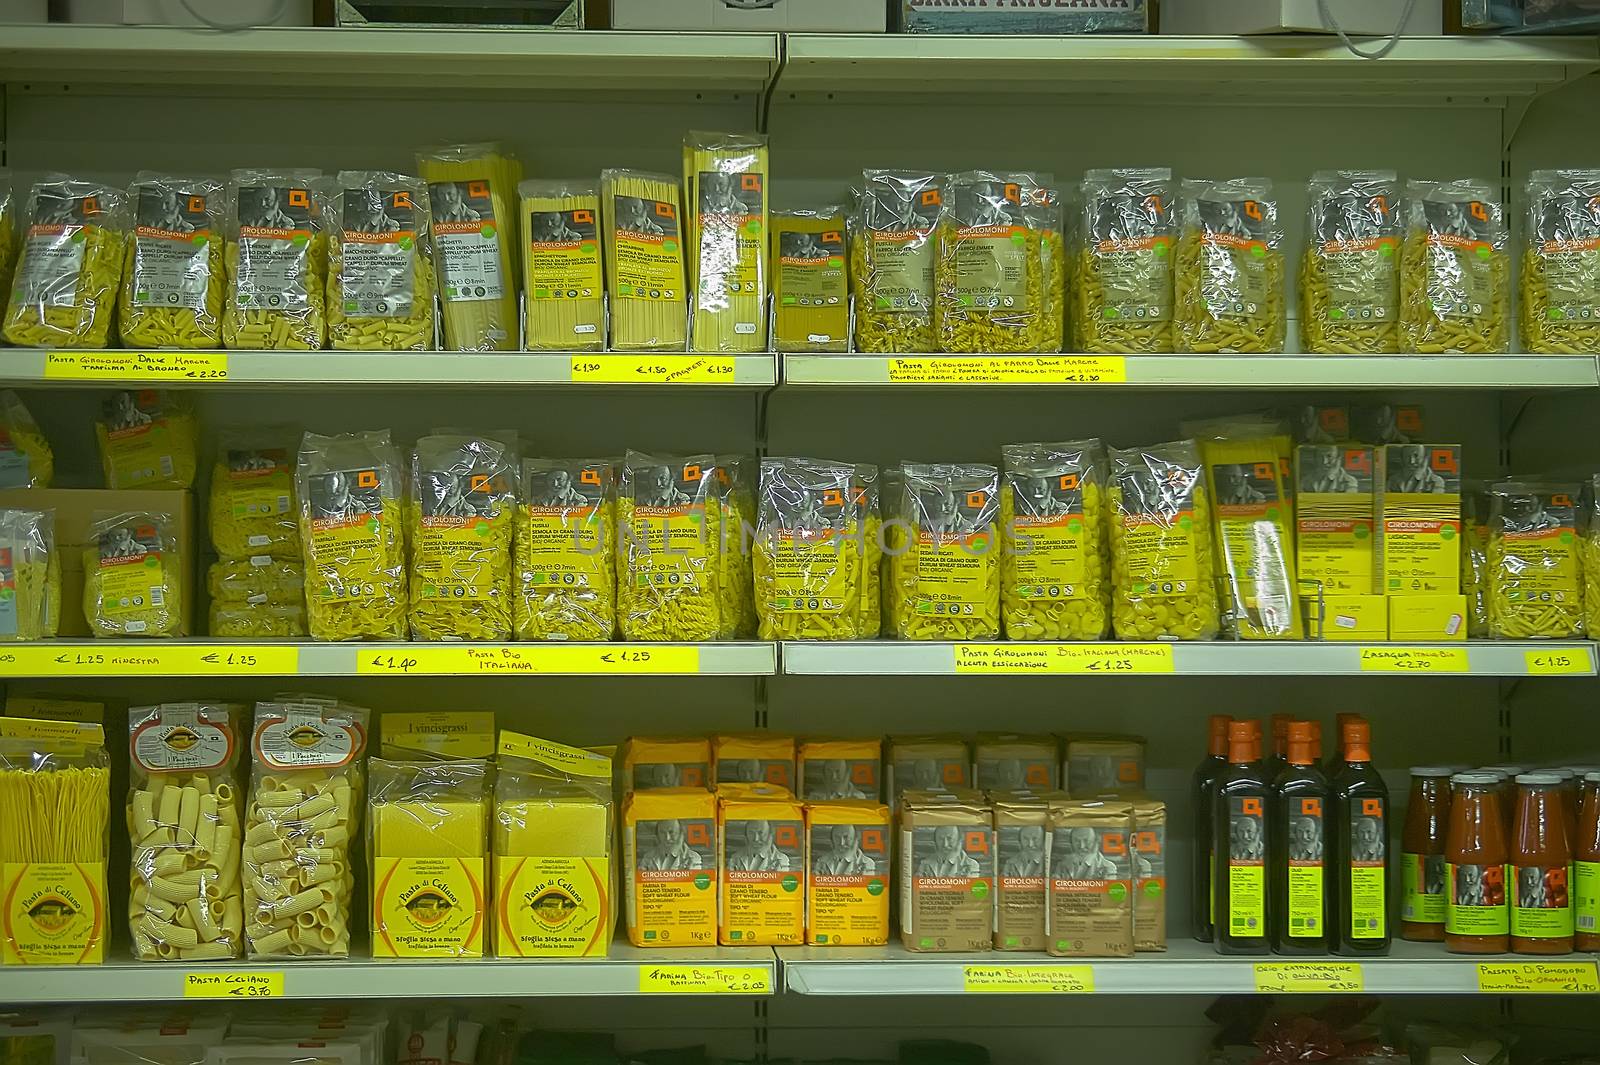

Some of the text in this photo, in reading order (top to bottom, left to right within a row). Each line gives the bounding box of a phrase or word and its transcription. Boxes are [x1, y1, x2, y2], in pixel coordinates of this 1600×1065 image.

[435, 222, 481, 233] GIROLOMONI
[617, 231, 662, 245] GIROLOMONI
[533, 243, 581, 251] GIROLOMONI
[200, 370, 227, 378] 2.20
[648, 366, 667, 374] 1.50
[717, 366, 733, 374] 1.30
[635, 506, 684, 515] GIROLOMONI
[1387, 521, 1439, 530] GIROLOMONI
[76, 654, 104, 664] 1.25
[227, 654, 257, 665] 1.25
[621, 651, 650, 660] 1.25
[387, 657, 418, 668] 1.40
[1104, 660, 1133, 670] 1.25
[1548, 657, 1570, 667] 1.25
[415, 723, 468, 735] vincisgrassi
[533, 743, 585, 761] vincisgrassi
[642, 872, 689, 880] GIROLOMONI
[729, 872, 777, 880] GIROLOMONI
[919, 878, 968, 886] GIROLOMONI
[399, 885, 420, 902] Pasta
[524, 884, 545, 902] Pasta
[1481, 965, 1518, 975] PASSATA
[1535, 964, 1586, 975] POMODORO
[189, 975, 220, 984] PASTA
[247, 986, 271, 996] 3.70
[742, 982, 765, 990] 2.05
